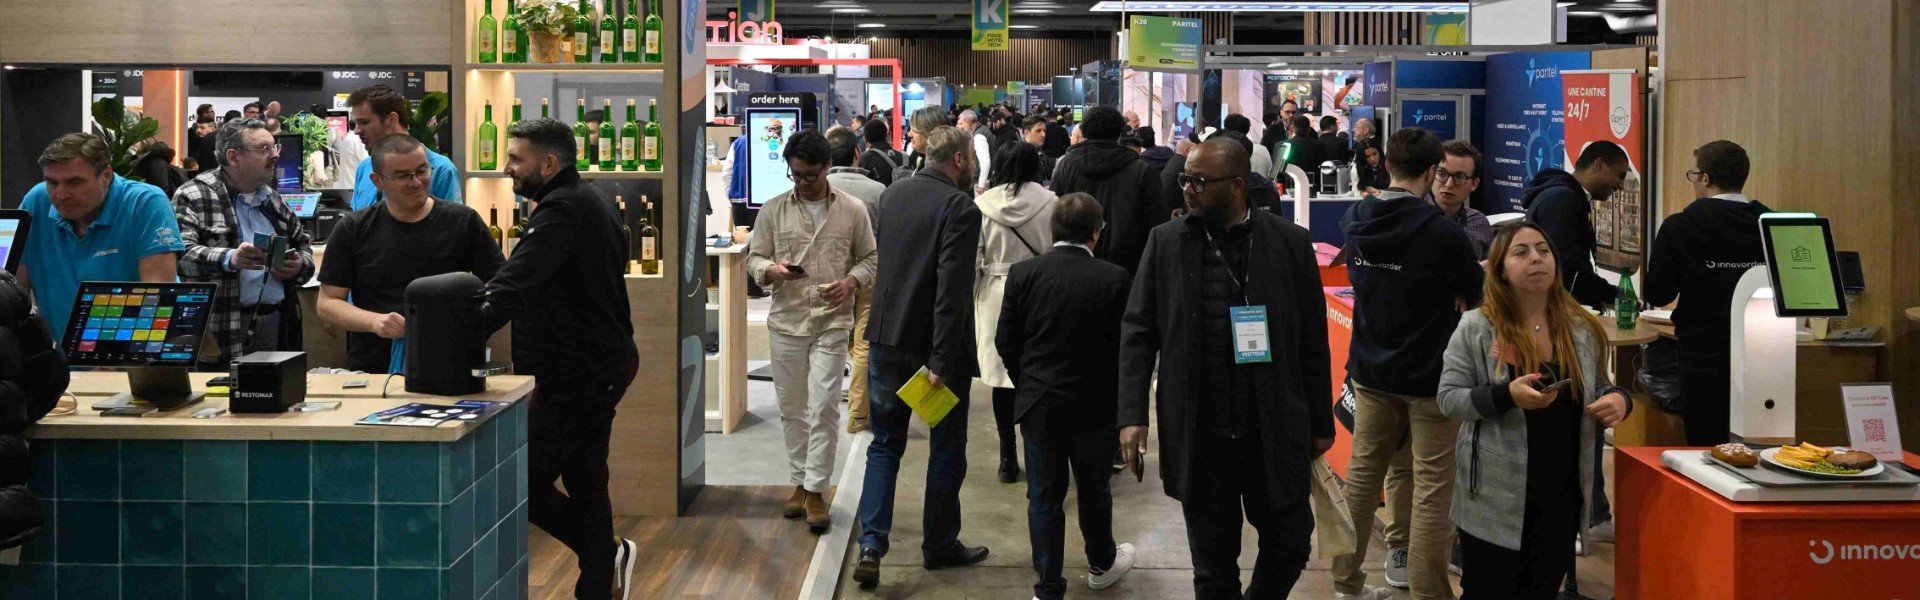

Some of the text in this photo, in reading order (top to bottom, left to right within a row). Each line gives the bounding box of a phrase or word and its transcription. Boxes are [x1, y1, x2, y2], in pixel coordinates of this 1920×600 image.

[980, 0, 1004, 23] K
[1536, 64, 1557, 81] paritel
[751, 95, 800, 104] order here
[1567, 88, 1607, 97] UNE CANTINE
[1567, 99, 1590, 121] 24/7
